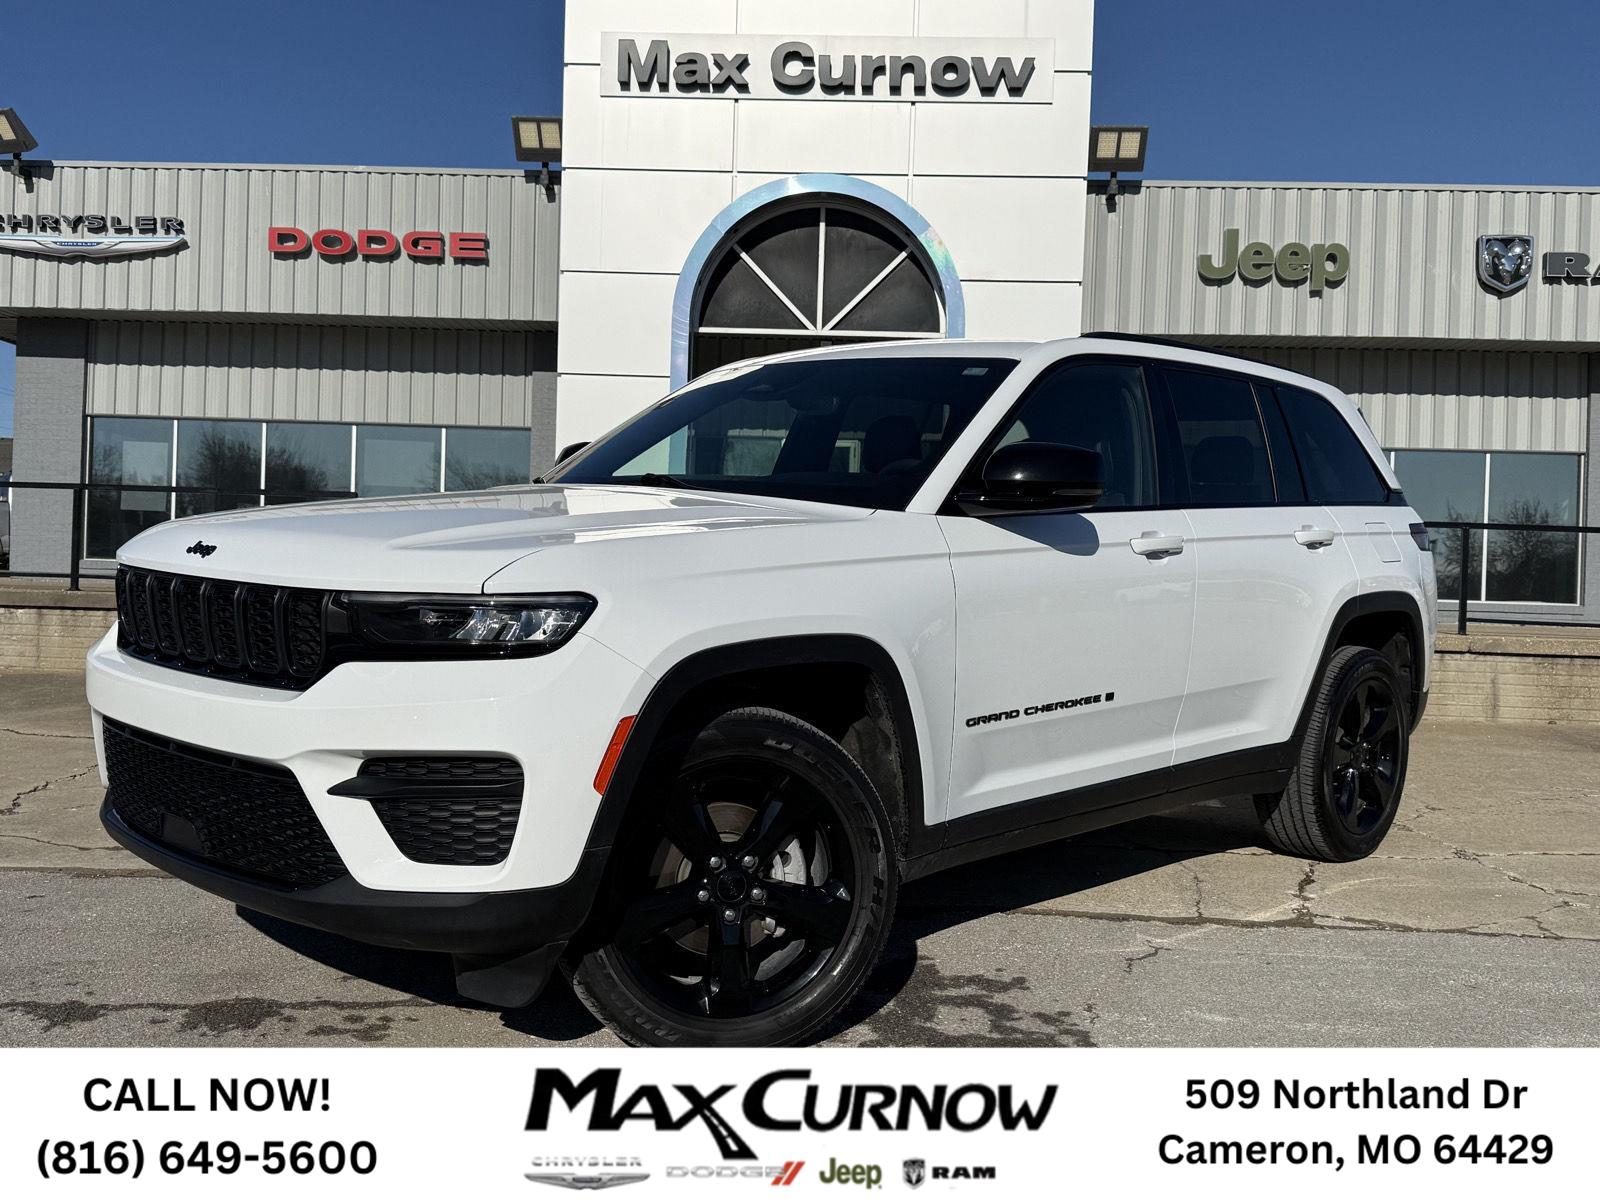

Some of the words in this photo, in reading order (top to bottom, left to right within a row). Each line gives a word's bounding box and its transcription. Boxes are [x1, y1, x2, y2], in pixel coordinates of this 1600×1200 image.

[616, 38, 751, 93] Max
[770, 41, 1036, 98] Curnow
[0, 213, 185, 234] HRYSLER
[268, 226, 489, 262] DODGE
[1198, 228, 1350, 295] Jeep
[186, 540, 218, 559] Jeep
[965, 709, 1020, 728] GRAND
[1023, 694, 1102, 716] CHEROKEE
